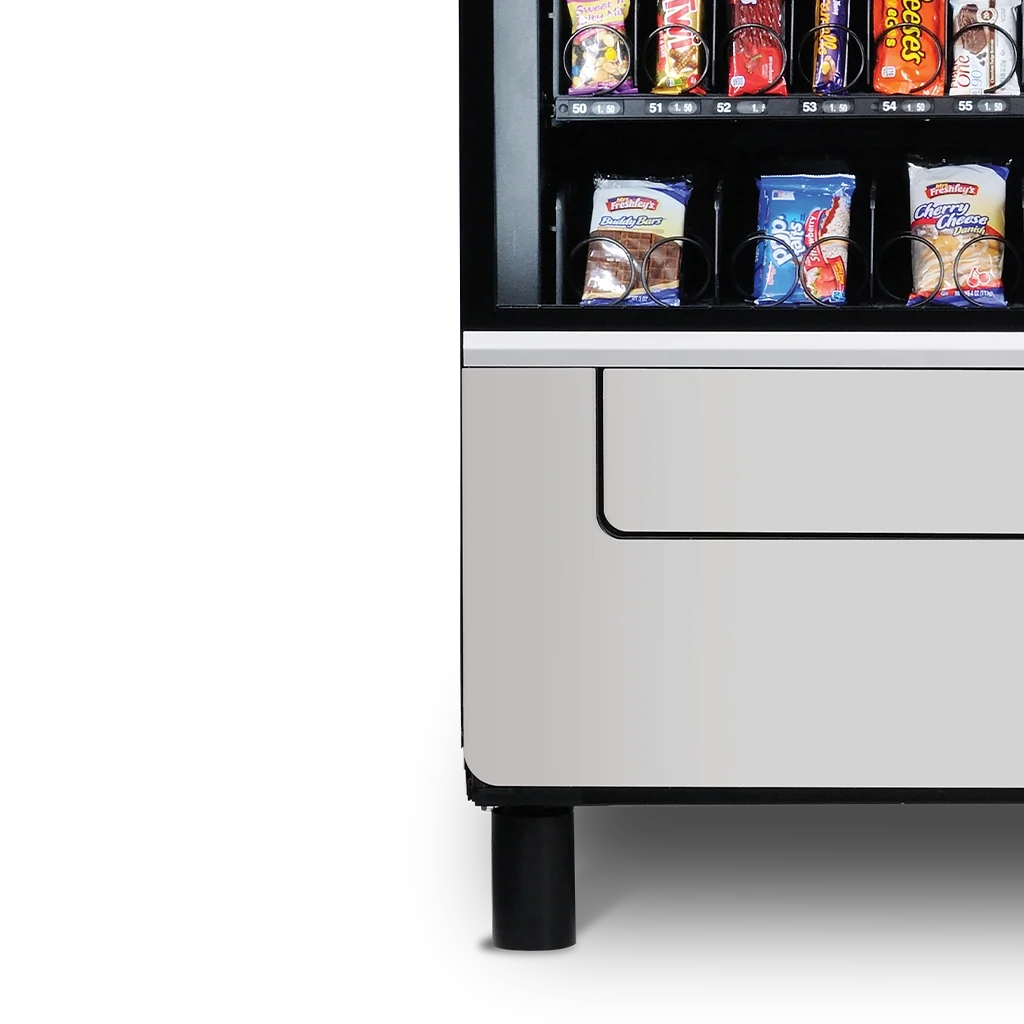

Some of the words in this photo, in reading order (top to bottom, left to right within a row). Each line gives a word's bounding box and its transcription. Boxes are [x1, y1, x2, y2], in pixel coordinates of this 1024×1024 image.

[576, 2, 613, 16] Sweet
[607, 8, 625, 19] Mix
[957, 55, 971, 88] One
[572, 103, 587, 114] 50
[649, 103, 663, 113] 51
[717, 102, 732, 113] 52
[802, 102, 817, 112] 53
[882, 101, 897, 111] 54
[958, 101, 973, 111] 55
[930, 185, 976, 197] Freshley's
[610, 198, 656, 211] Freshley's
[915, 202, 970, 220] Cherry
[600, 216, 636, 228] Buddy
[637, 215, 664, 226] Bars
[936, 214, 989, 230] Cheese
[953, 225, 986, 236] Danish
